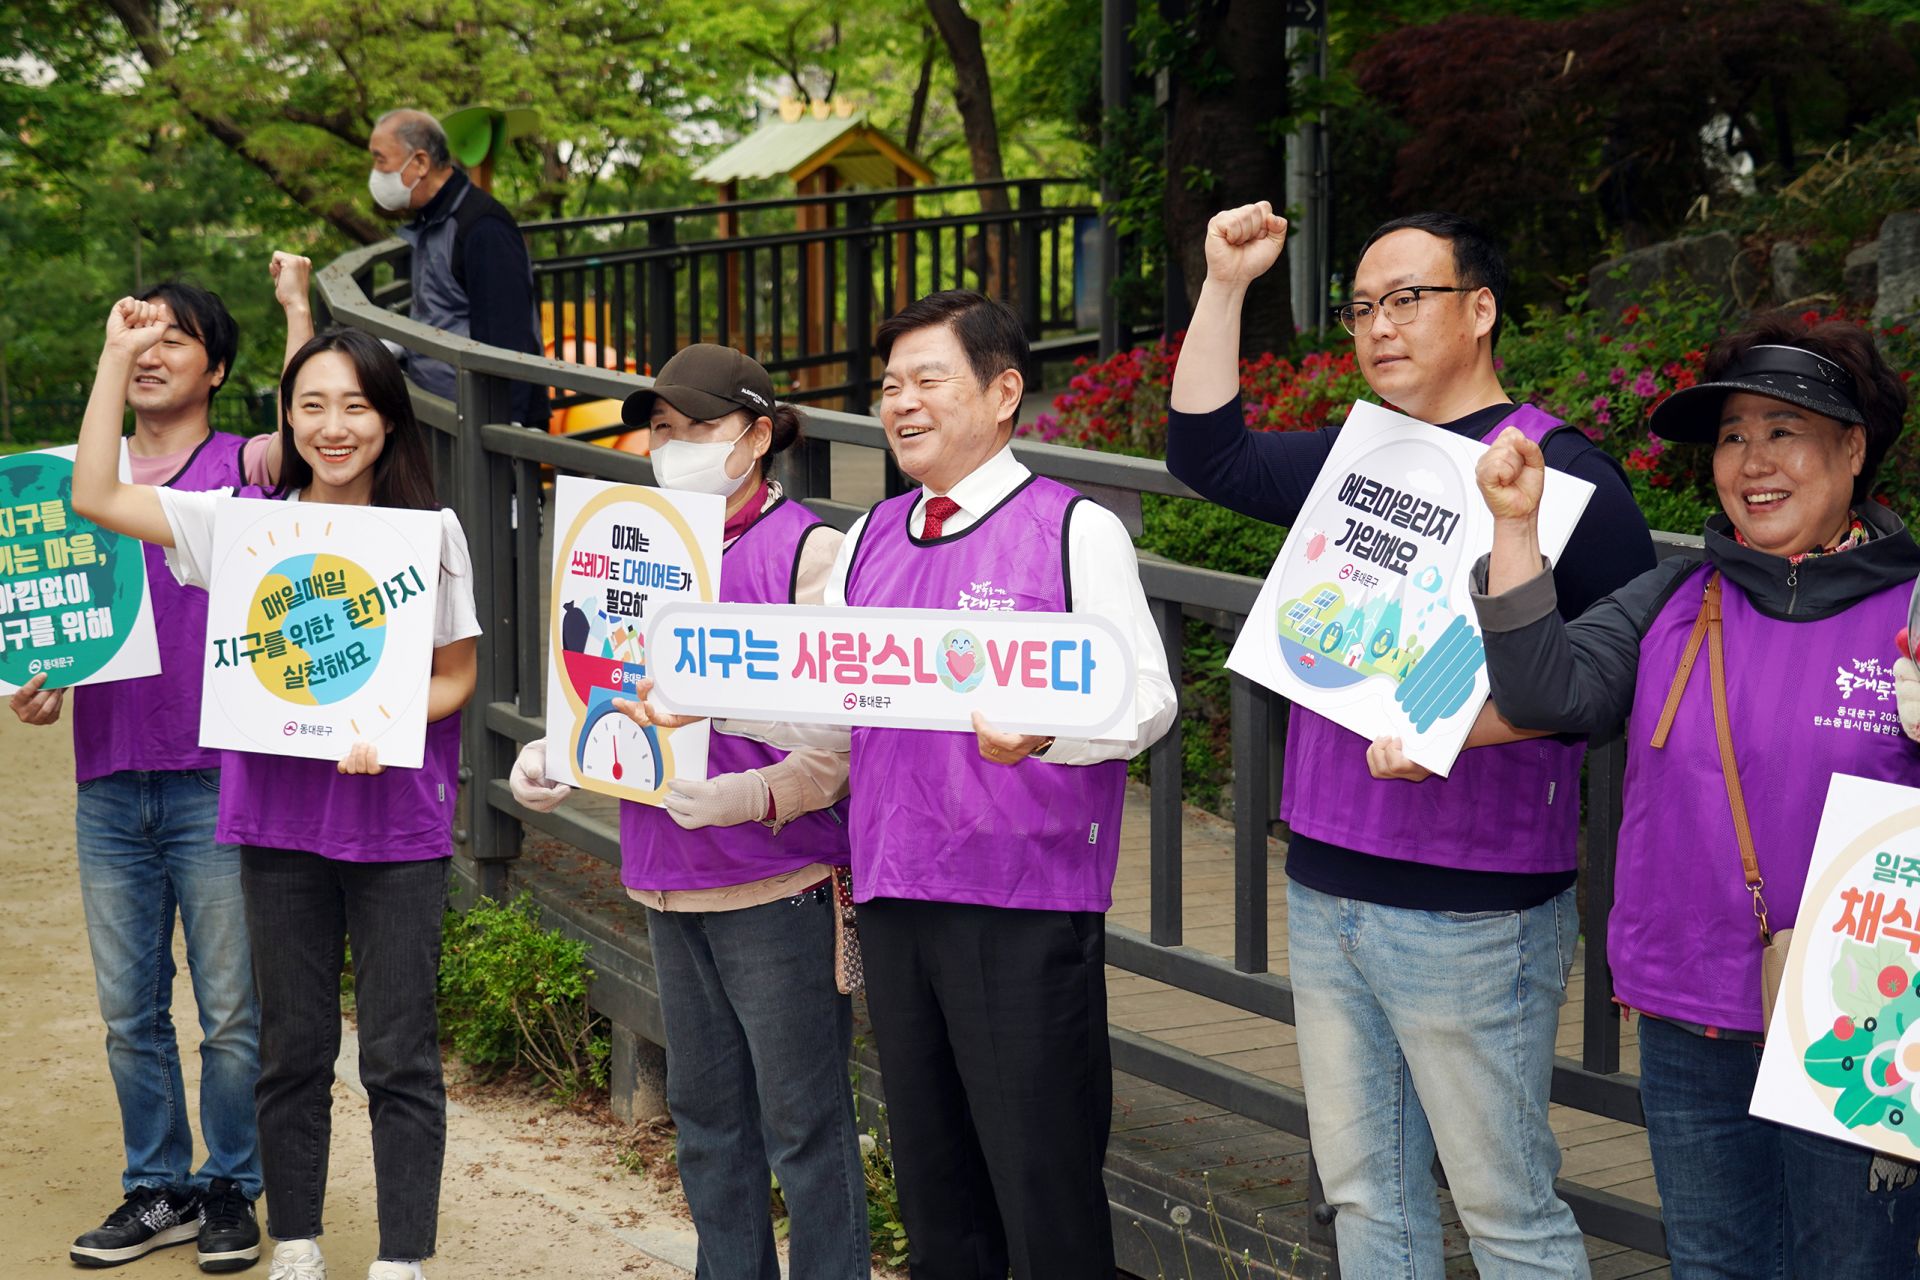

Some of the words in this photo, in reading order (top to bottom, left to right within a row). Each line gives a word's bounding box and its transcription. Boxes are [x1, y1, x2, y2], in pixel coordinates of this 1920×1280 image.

[0, 499, 66, 538] 지구를
[1338, 472, 1461, 545] 에코마일리지
[44, 533, 107, 569] 마음,
[611, 524, 650, 553] 이제는
[1334, 517, 1418, 576] 가입해요
[571, 550, 620, 581] 쓰레기도
[623, 558, 693, 592] 다이어트가
[1352, 569, 1380, 590] 동대문구
[261, 569, 347, 620] 매일매일
[0, 615, 55, 652] 구를
[61, 606, 114, 642] 위해
[213, 630, 288, 669] 지구를
[289, 613, 335, 649] 위한
[342, 565, 426, 630] 한가지
[43, 656, 75, 670] 동대문구
[283, 641, 371, 690] 실천해요
[673, 626, 780, 681] 지구는
[623, 671, 646, 684] 동대문
[1835, 666, 1897, 700] 동대문
[858, 695, 892, 709] 동대문구
[1837, 706, 1876, 719] 동대문구
[300, 724, 333, 736] 동대문구
